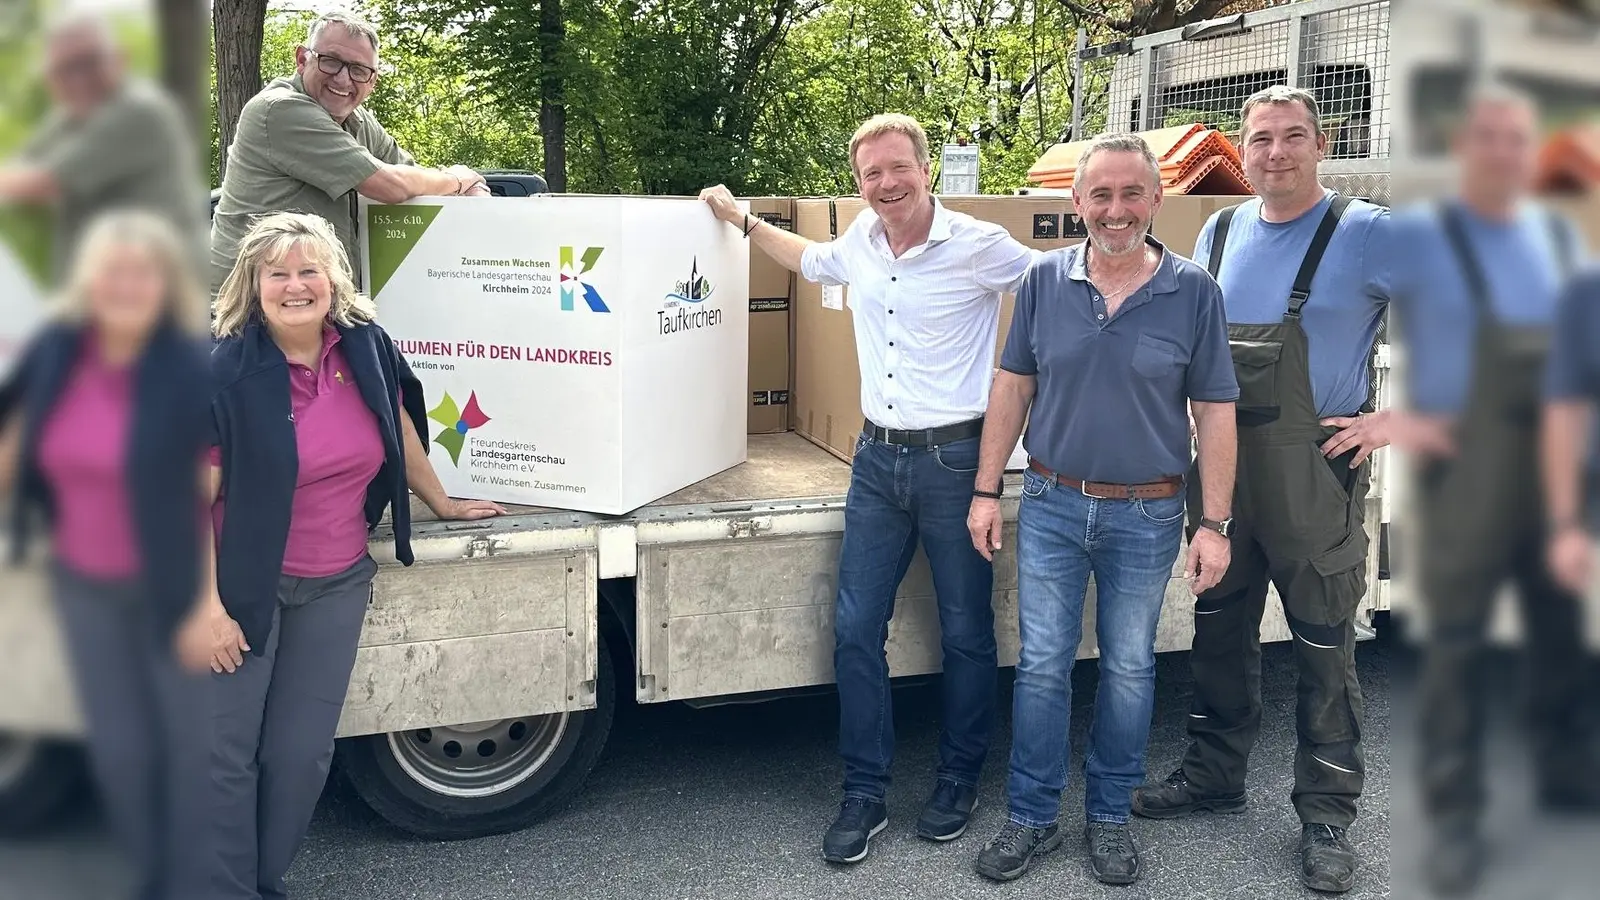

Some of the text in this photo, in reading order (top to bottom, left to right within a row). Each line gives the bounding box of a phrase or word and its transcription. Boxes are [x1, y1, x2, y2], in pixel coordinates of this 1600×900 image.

[373, 215, 393, 225] 15.5.
[403, 215, 424, 225] 6.10.
[386, 229, 406, 239] 2024
[461, 257, 550, 268] Zusammen Wachsen
[427, 269, 552, 283] Bayerische Landesgartenschau
[482, 284, 552, 295] Kirchheim 2024
[657, 305, 722, 335] Taufkirchen
[457, 341, 486, 359] FÜR
[490, 345, 521, 360] DEN
[526, 347, 613, 366] LANDKREIS
[411, 361, 438, 371] Aktion
[471, 437, 537, 452] Freundeskreis
[471, 449, 566, 465] Landesgartenschau
[471, 460, 537, 474] Kirchheim e.V.
[471, 475, 587, 494] Wir. Wachsen. Zusammen
